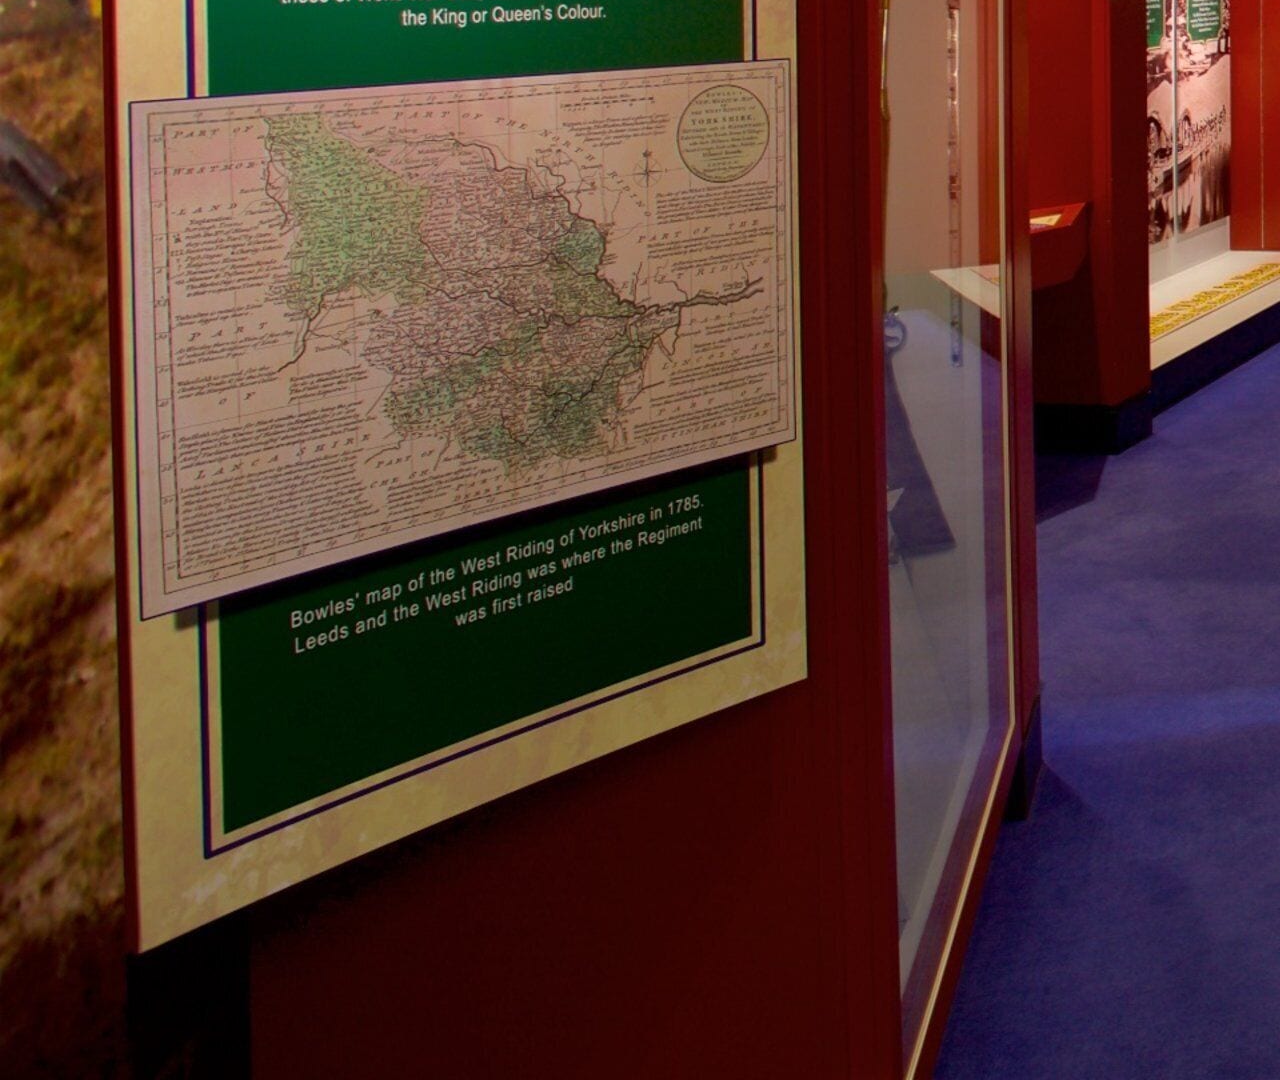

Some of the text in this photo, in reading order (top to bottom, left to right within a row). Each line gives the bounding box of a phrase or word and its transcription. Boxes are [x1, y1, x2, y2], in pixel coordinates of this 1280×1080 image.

[400, 3, 607, 29] the King or Queen's Colour.
[290, 493, 704, 629] Bowles' map of the West Riding of Yorkshire in 1785.
[294, 516, 703, 655] Leeds and the West Riding was where the Regiment
[455, 577, 573, 626] was first raised
